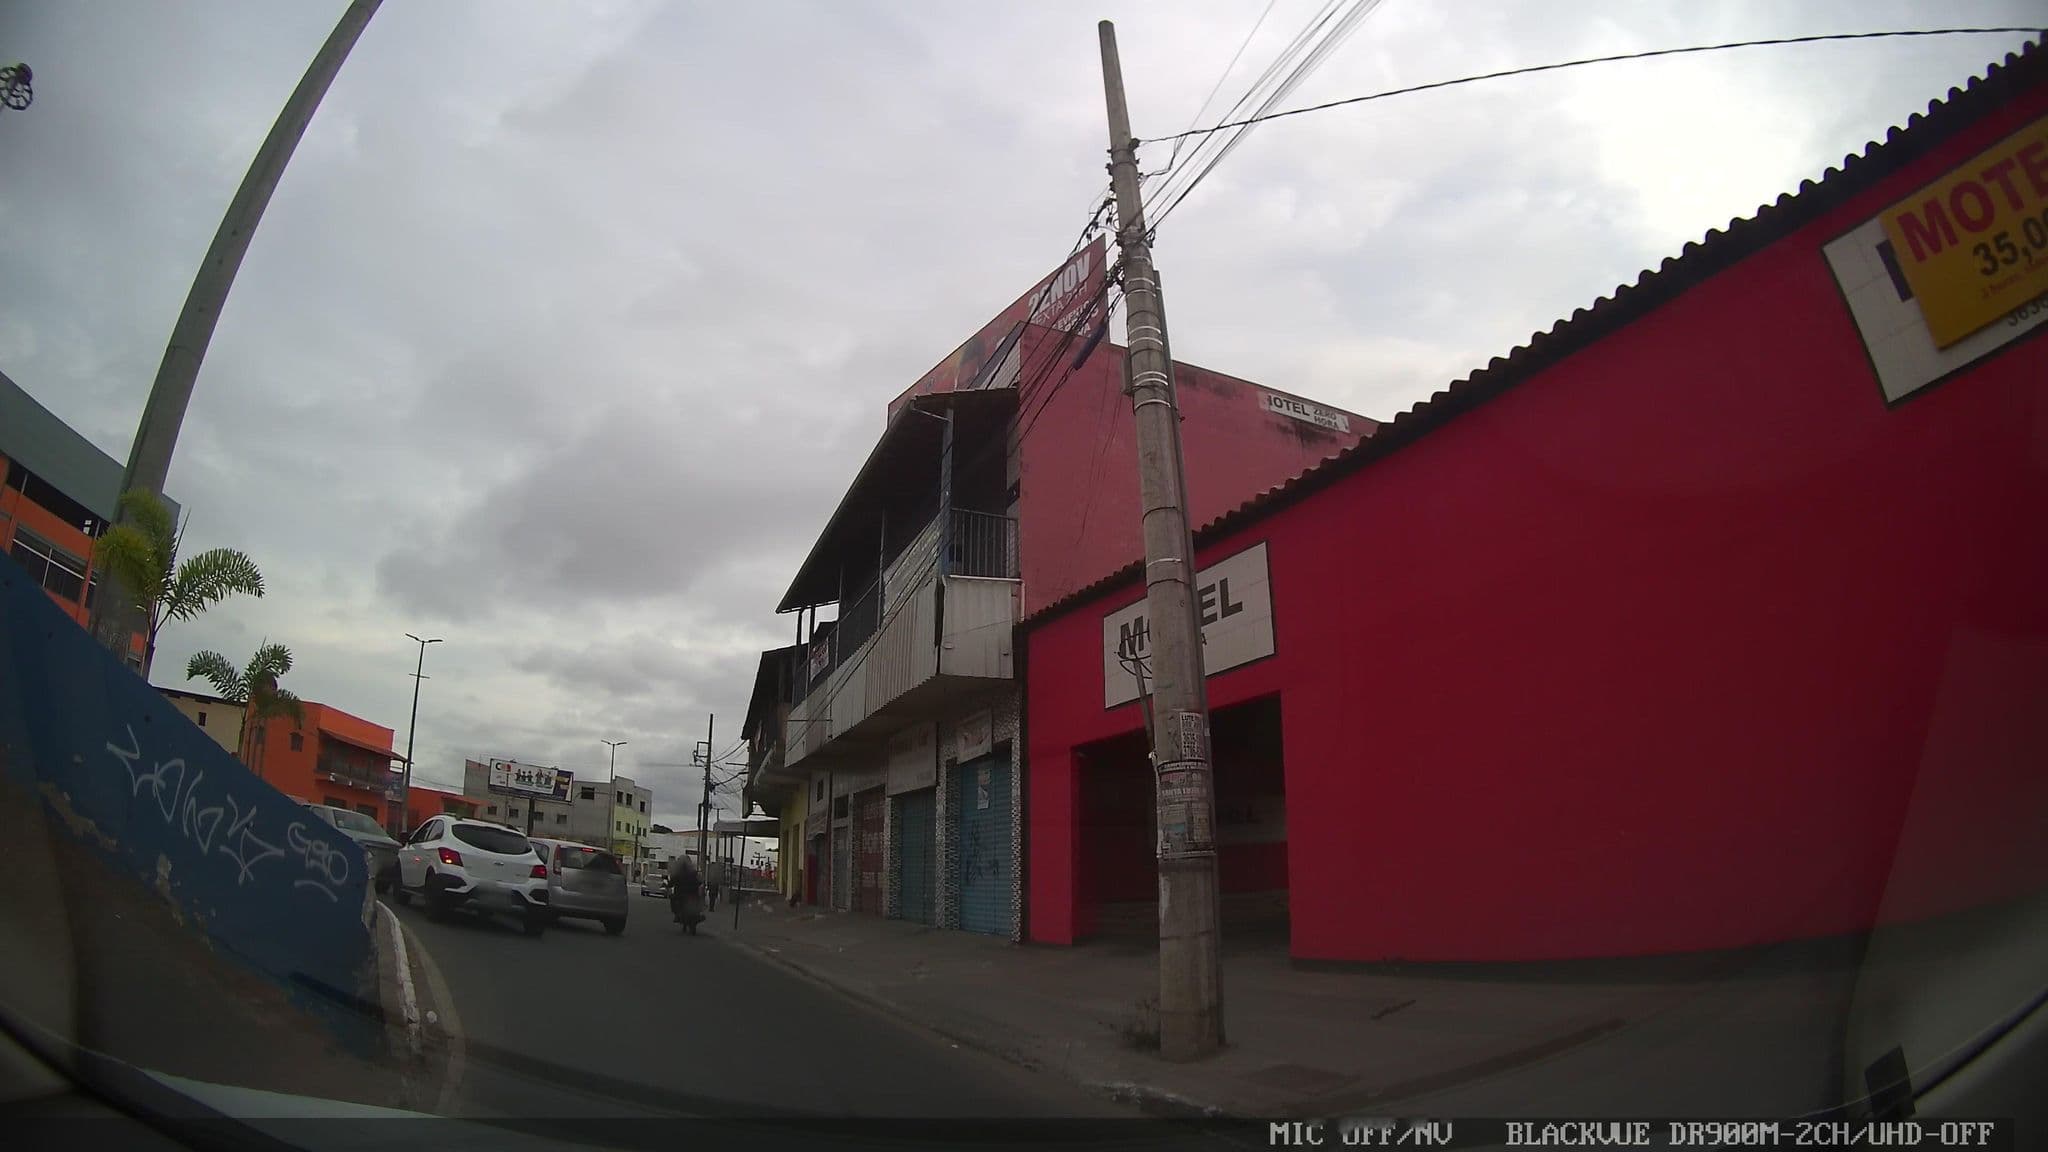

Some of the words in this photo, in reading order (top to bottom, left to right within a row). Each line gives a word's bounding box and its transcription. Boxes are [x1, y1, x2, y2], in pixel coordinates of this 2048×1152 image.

[1973, 206, 2048, 277] 35,0
[1314, 416, 1339, 430] HORA
[1119, 577, 1243, 659] MEL
